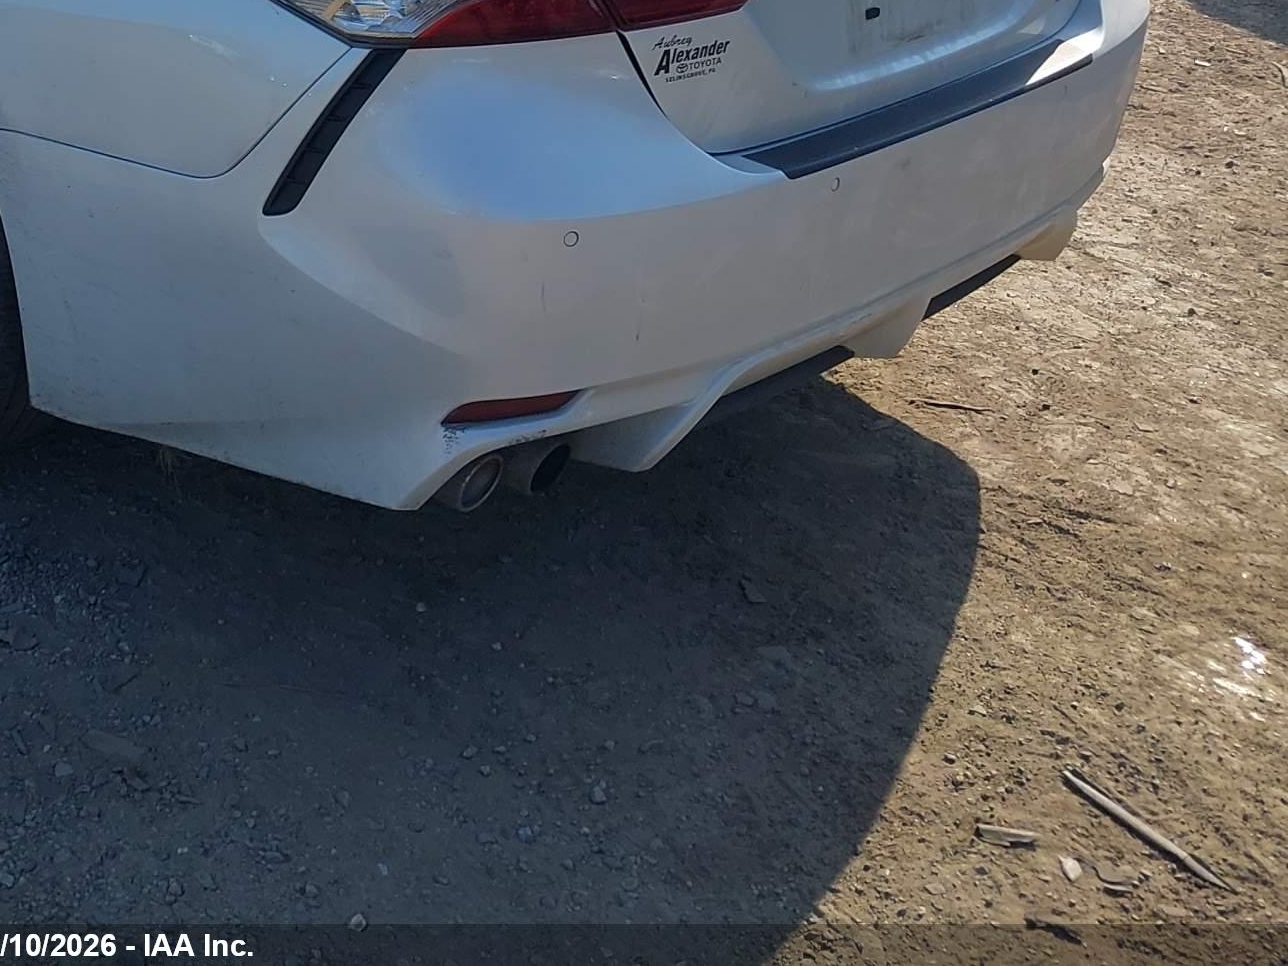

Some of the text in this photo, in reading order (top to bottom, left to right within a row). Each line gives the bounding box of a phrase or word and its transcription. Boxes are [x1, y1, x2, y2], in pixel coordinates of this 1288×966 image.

[652, 34, 692, 50] Aubrey
[653, 40, 730, 76] Alexander
[689, 57, 722, 70] TOYOTA
